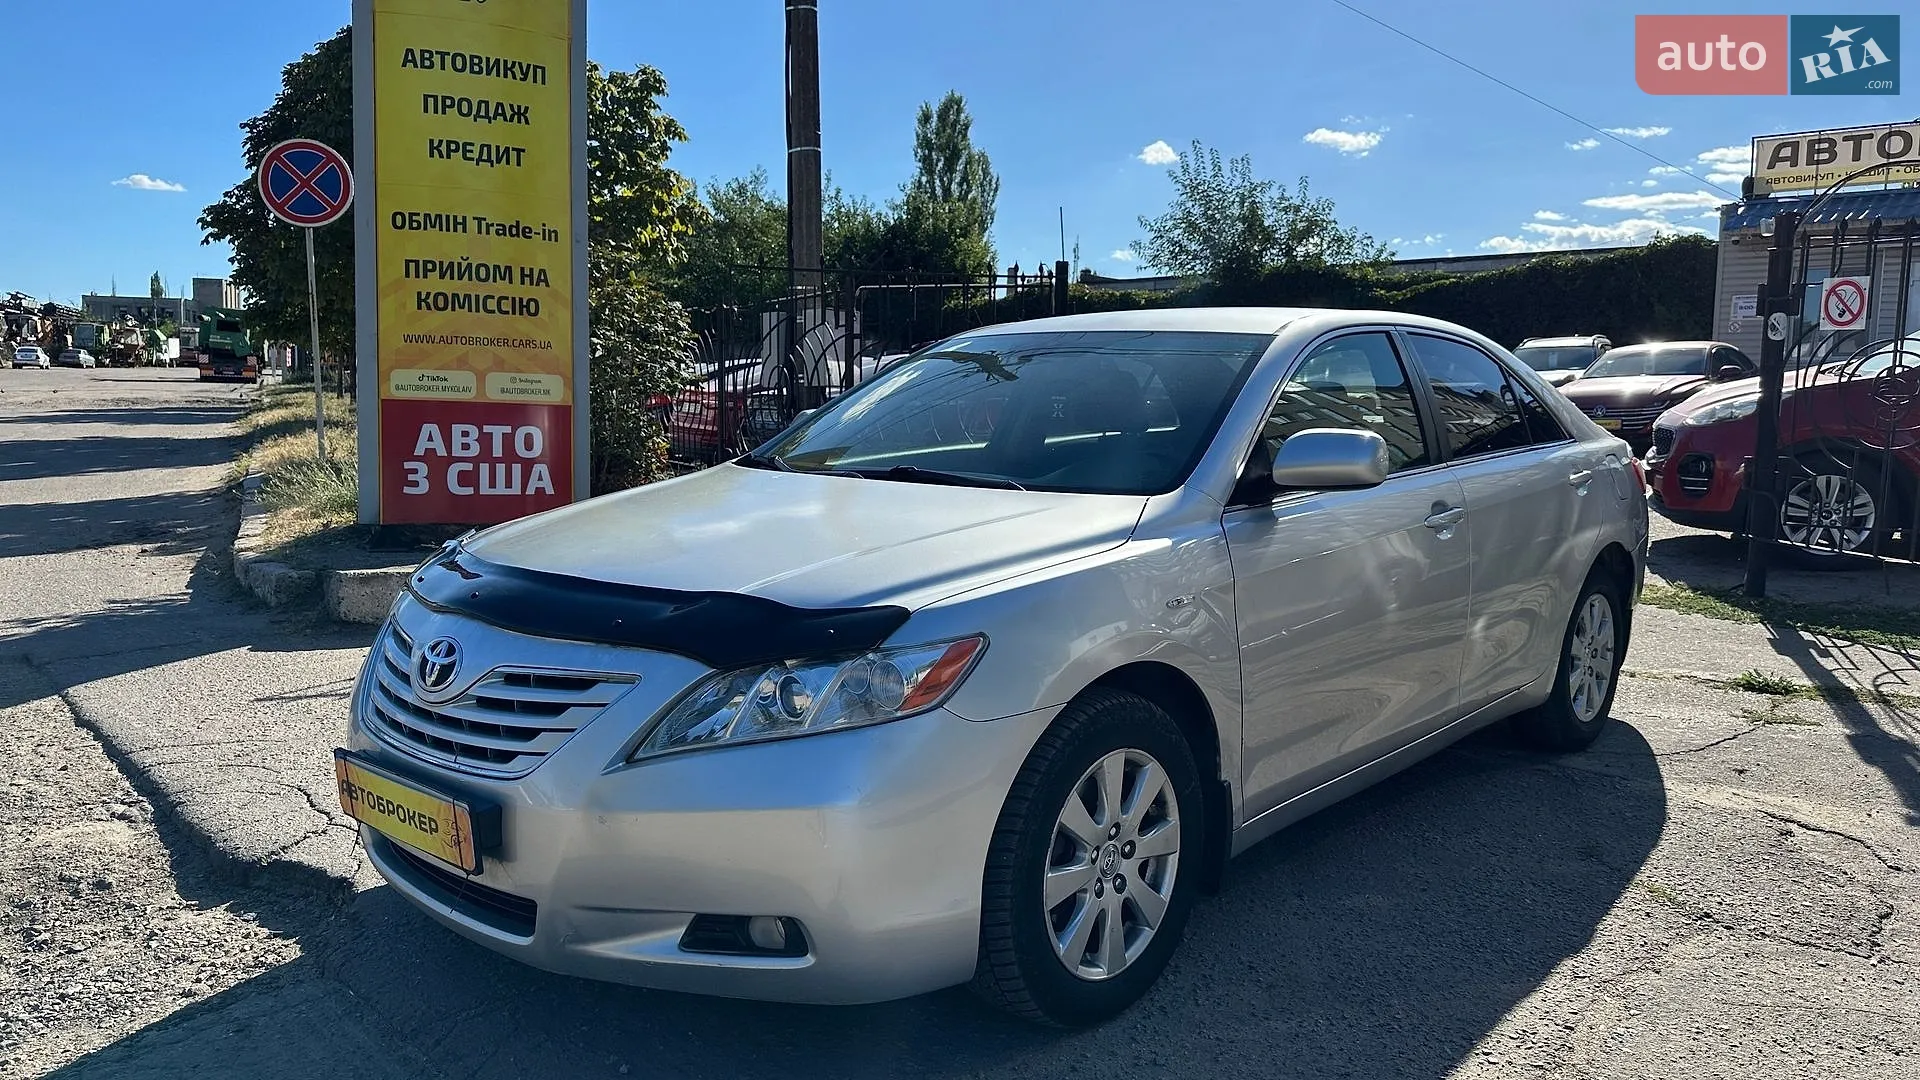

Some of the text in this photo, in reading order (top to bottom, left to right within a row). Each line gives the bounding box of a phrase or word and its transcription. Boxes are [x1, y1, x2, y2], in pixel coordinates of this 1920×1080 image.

[401, 47, 547, 86] АВТОВИКУП
[422, 93, 531, 126] ПРОДАЖ
[428, 138, 526, 168] КРЕДИТ
[1766, 129, 1920, 170] АВТО
[1765, 172, 1834, 185] АВТОВИКУП
[391, 210, 559, 243] ОБМІН Trade-in
[403, 256, 550, 288] ПРИЙОМ НА
[416, 290, 540, 317] КОМІССІЮ
[402, 333, 553, 350] WWW.AUTOBROKER.CARS.UA
[413, 423, 543, 458] АВТО
[446, 462, 555, 495] США
[341, 779, 439, 836] АВТОБРОКЕР
